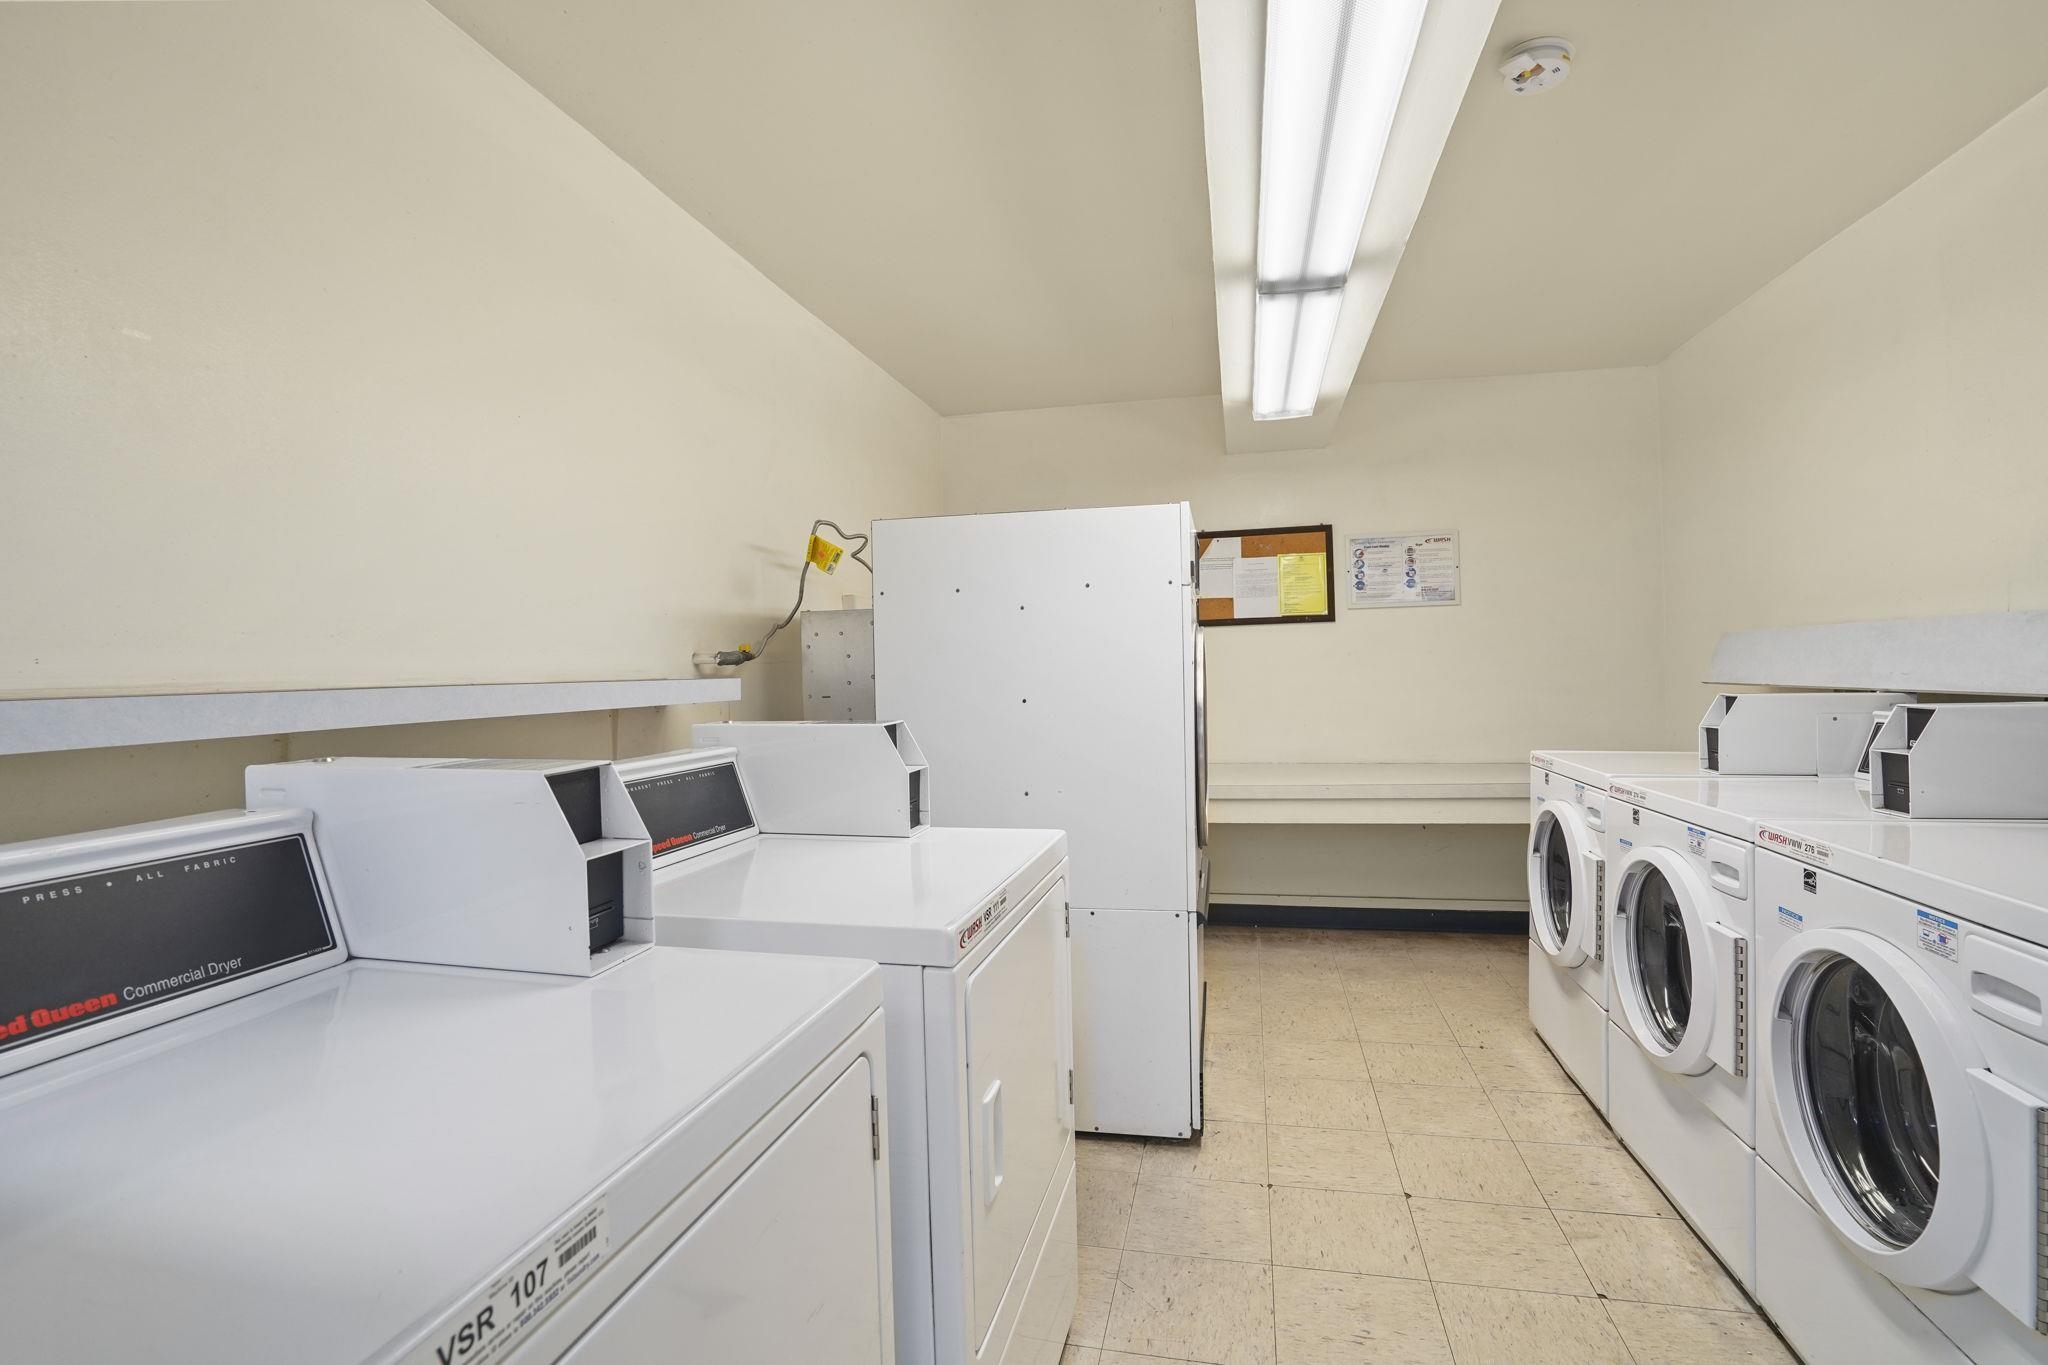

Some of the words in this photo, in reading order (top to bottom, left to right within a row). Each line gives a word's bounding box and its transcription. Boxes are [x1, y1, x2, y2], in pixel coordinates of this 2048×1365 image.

[670, 833, 693, 846] Queen
[693, 827, 715, 840] Commercial
[715, 825, 726, 833] Dryer
[1768, 831, 1788, 845] WASH
[1787, 838, 1803, 850] VWW
[22, 885, 84, 904] PRESS
[136, 870, 165, 882] ALL
[184, 856, 238, 873] FABRIC
[31, 992, 118, 1027] Queen
[123, 963, 205, 1001] Commercial
[208, 955, 243, 981] Dryer
[436, 1305, 496, 1365] VSR
[510, 1256, 549, 1308] 107
